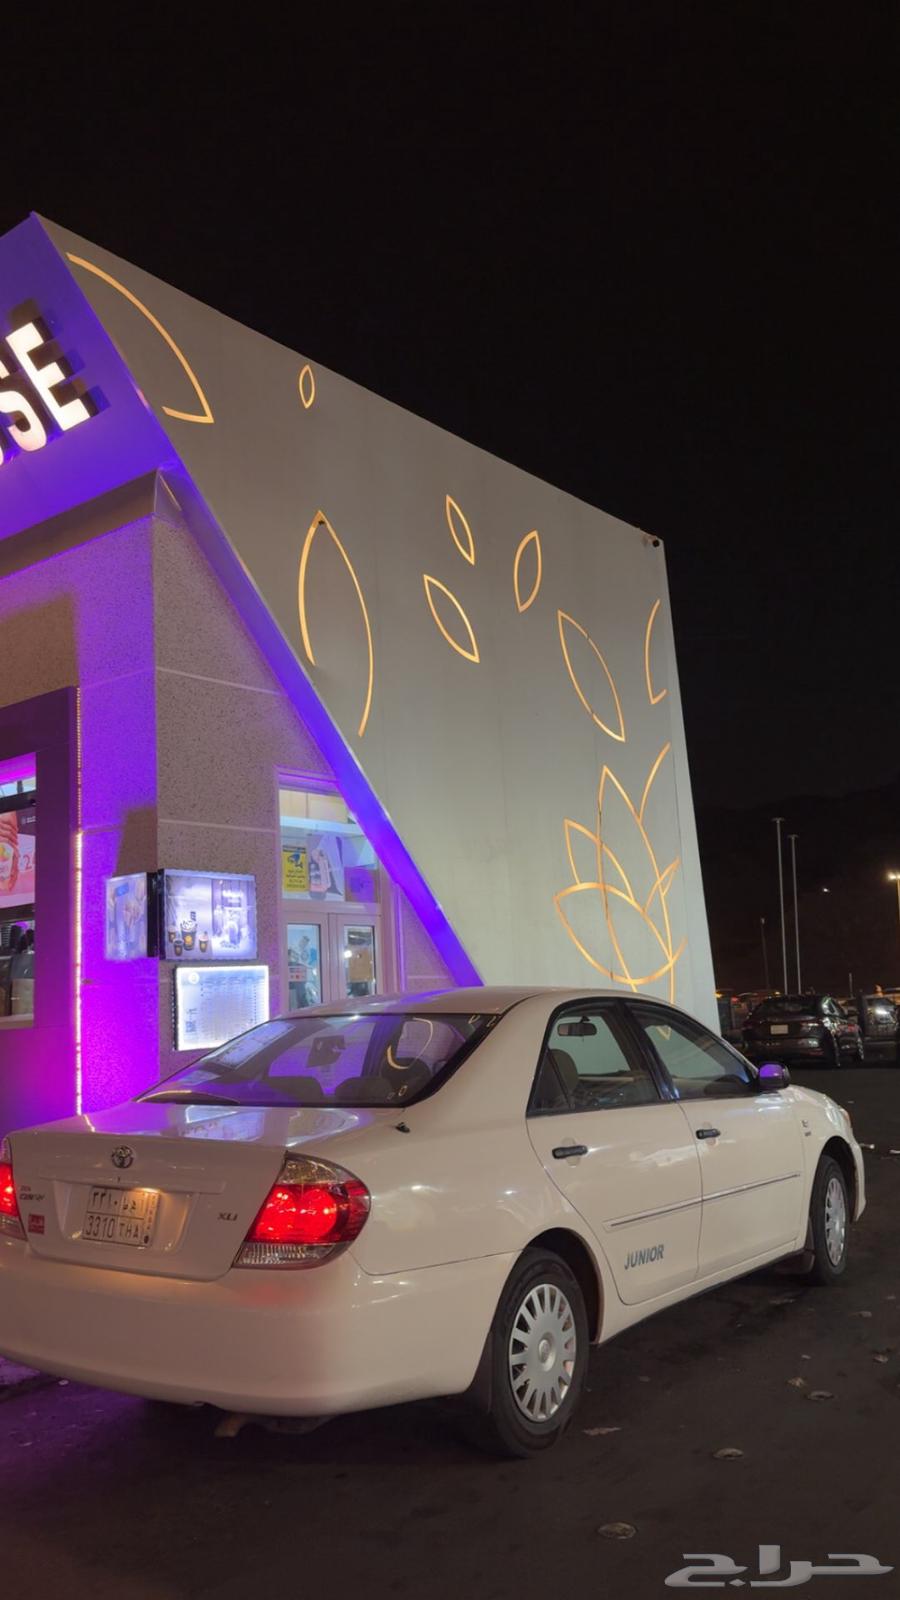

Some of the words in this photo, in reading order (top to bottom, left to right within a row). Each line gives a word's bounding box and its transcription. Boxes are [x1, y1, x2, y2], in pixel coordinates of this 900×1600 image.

[0, 322, 91, 466] SE
[85, 1214, 116, 1240] 3310
[624, 1244, 665, 1271] JUNIOR
